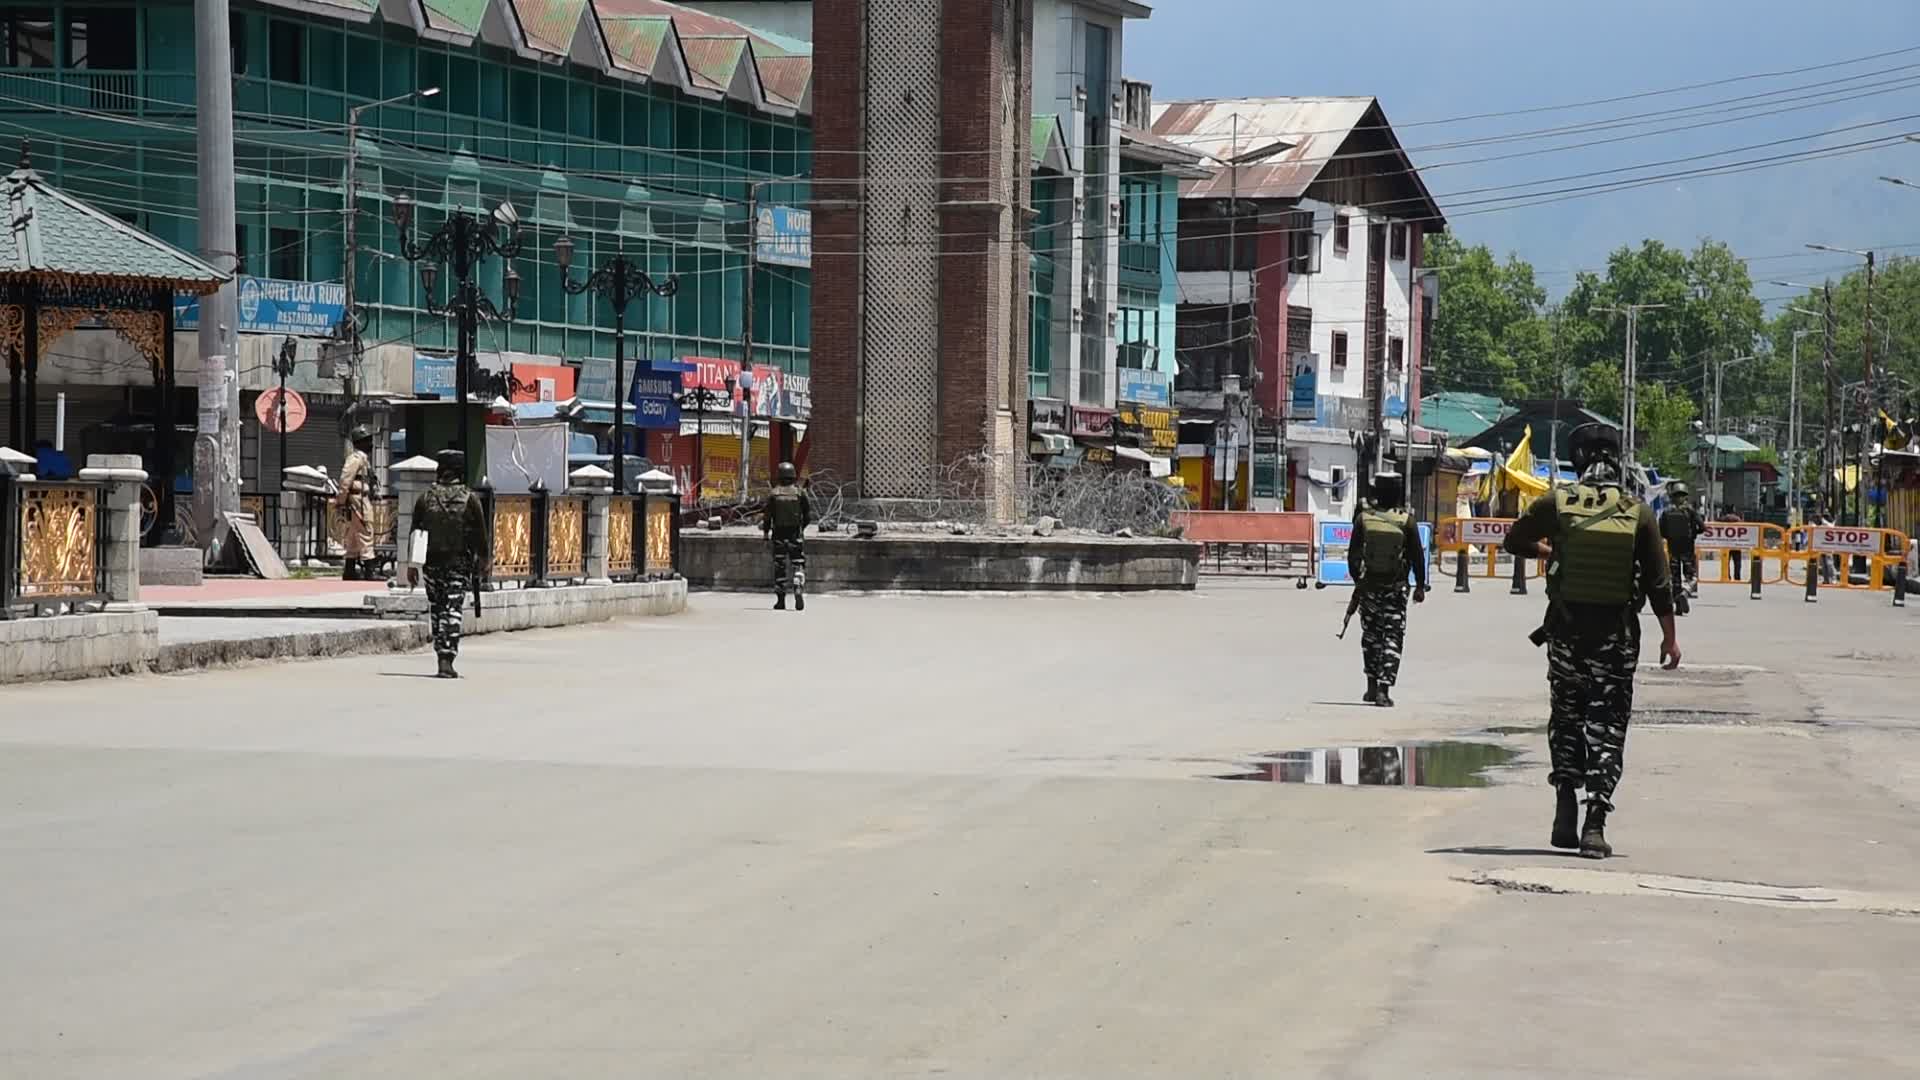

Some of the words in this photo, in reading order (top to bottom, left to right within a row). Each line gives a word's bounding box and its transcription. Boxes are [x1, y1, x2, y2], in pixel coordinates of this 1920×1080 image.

[261, 282, 289, 301] HOTEL
[292, 283, 316, 303] LALA
[277, 311, 329, 326] RESTAURANT
[638, 378, 672, 395] SAMSUNG
[642, 400, 667, 419] Galaxy
[1473, 522, 1511, 534] STOP
[1703, 526, 1748, 539] STOP
[1824, 530, 1870, 543] STOP
